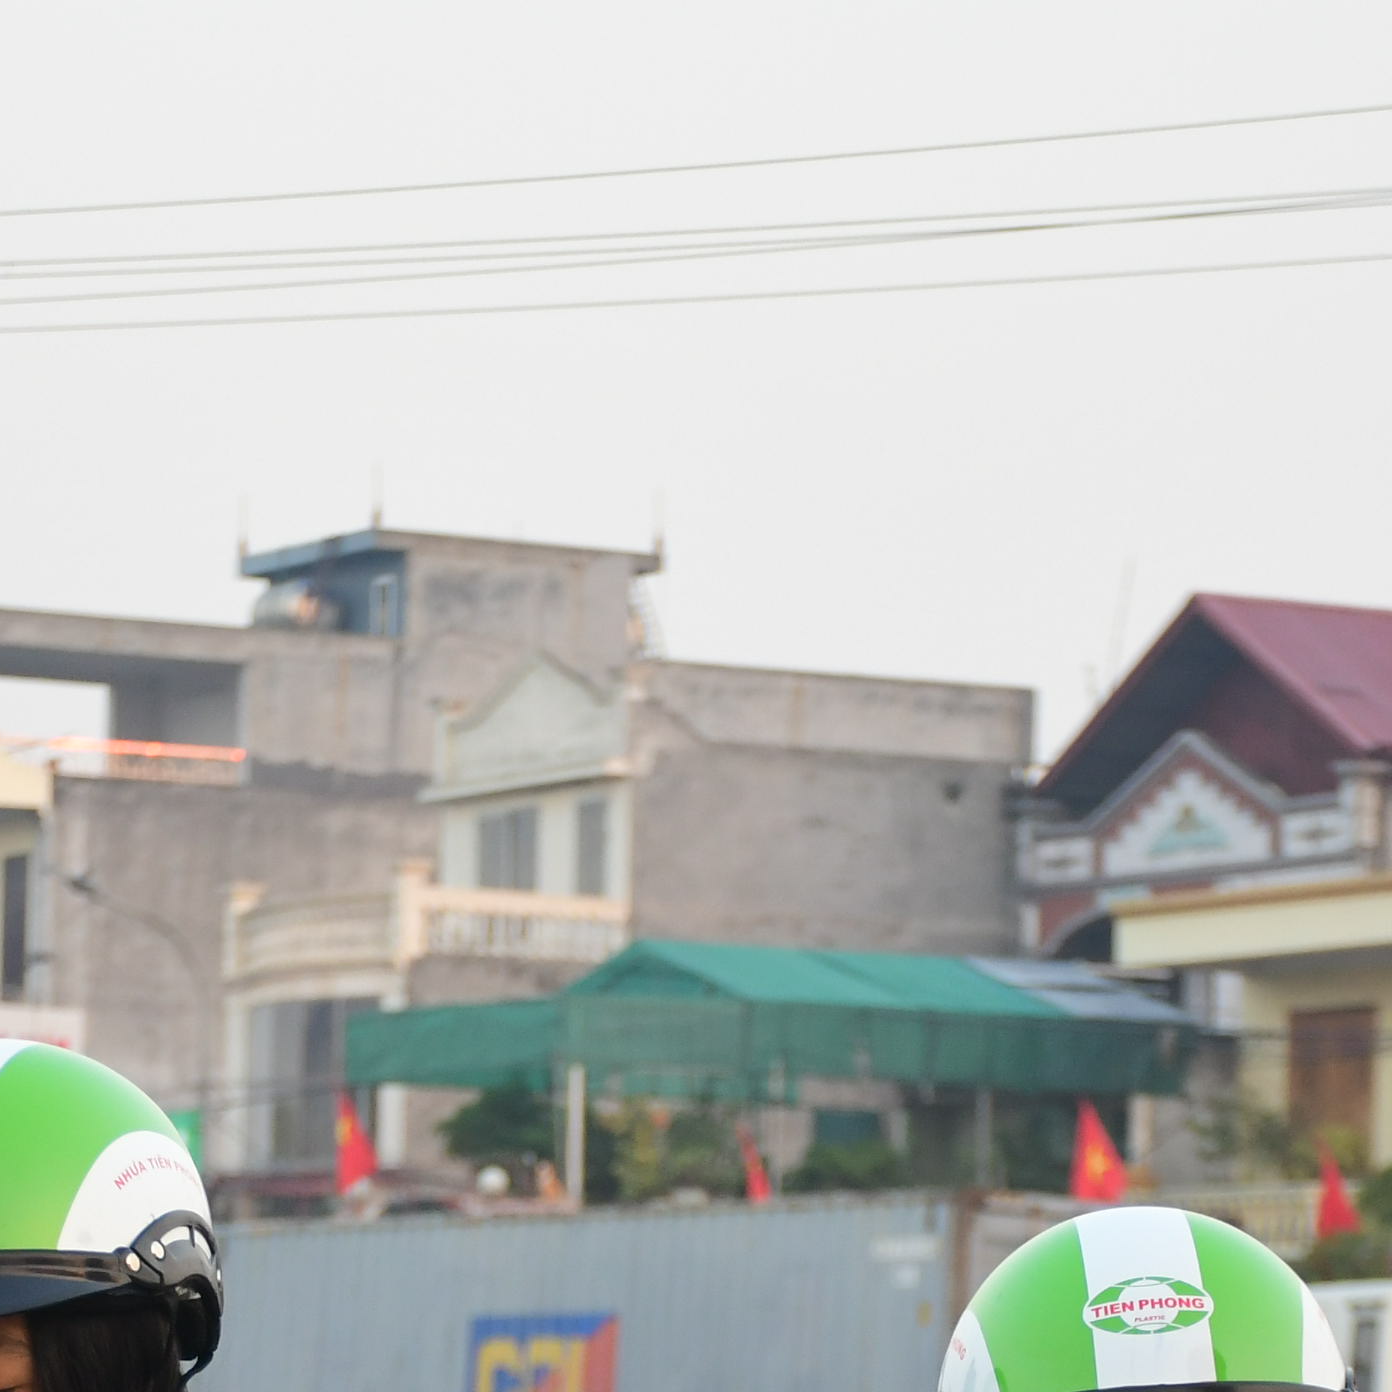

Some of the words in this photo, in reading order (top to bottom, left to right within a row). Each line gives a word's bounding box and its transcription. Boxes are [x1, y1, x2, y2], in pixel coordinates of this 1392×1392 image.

[1091, 1301, 1135, 1318] TIEN
[1138, 1297, 1205, 1311] PHONG
[1134, 1314, 1166, 1323] PLASTIC
